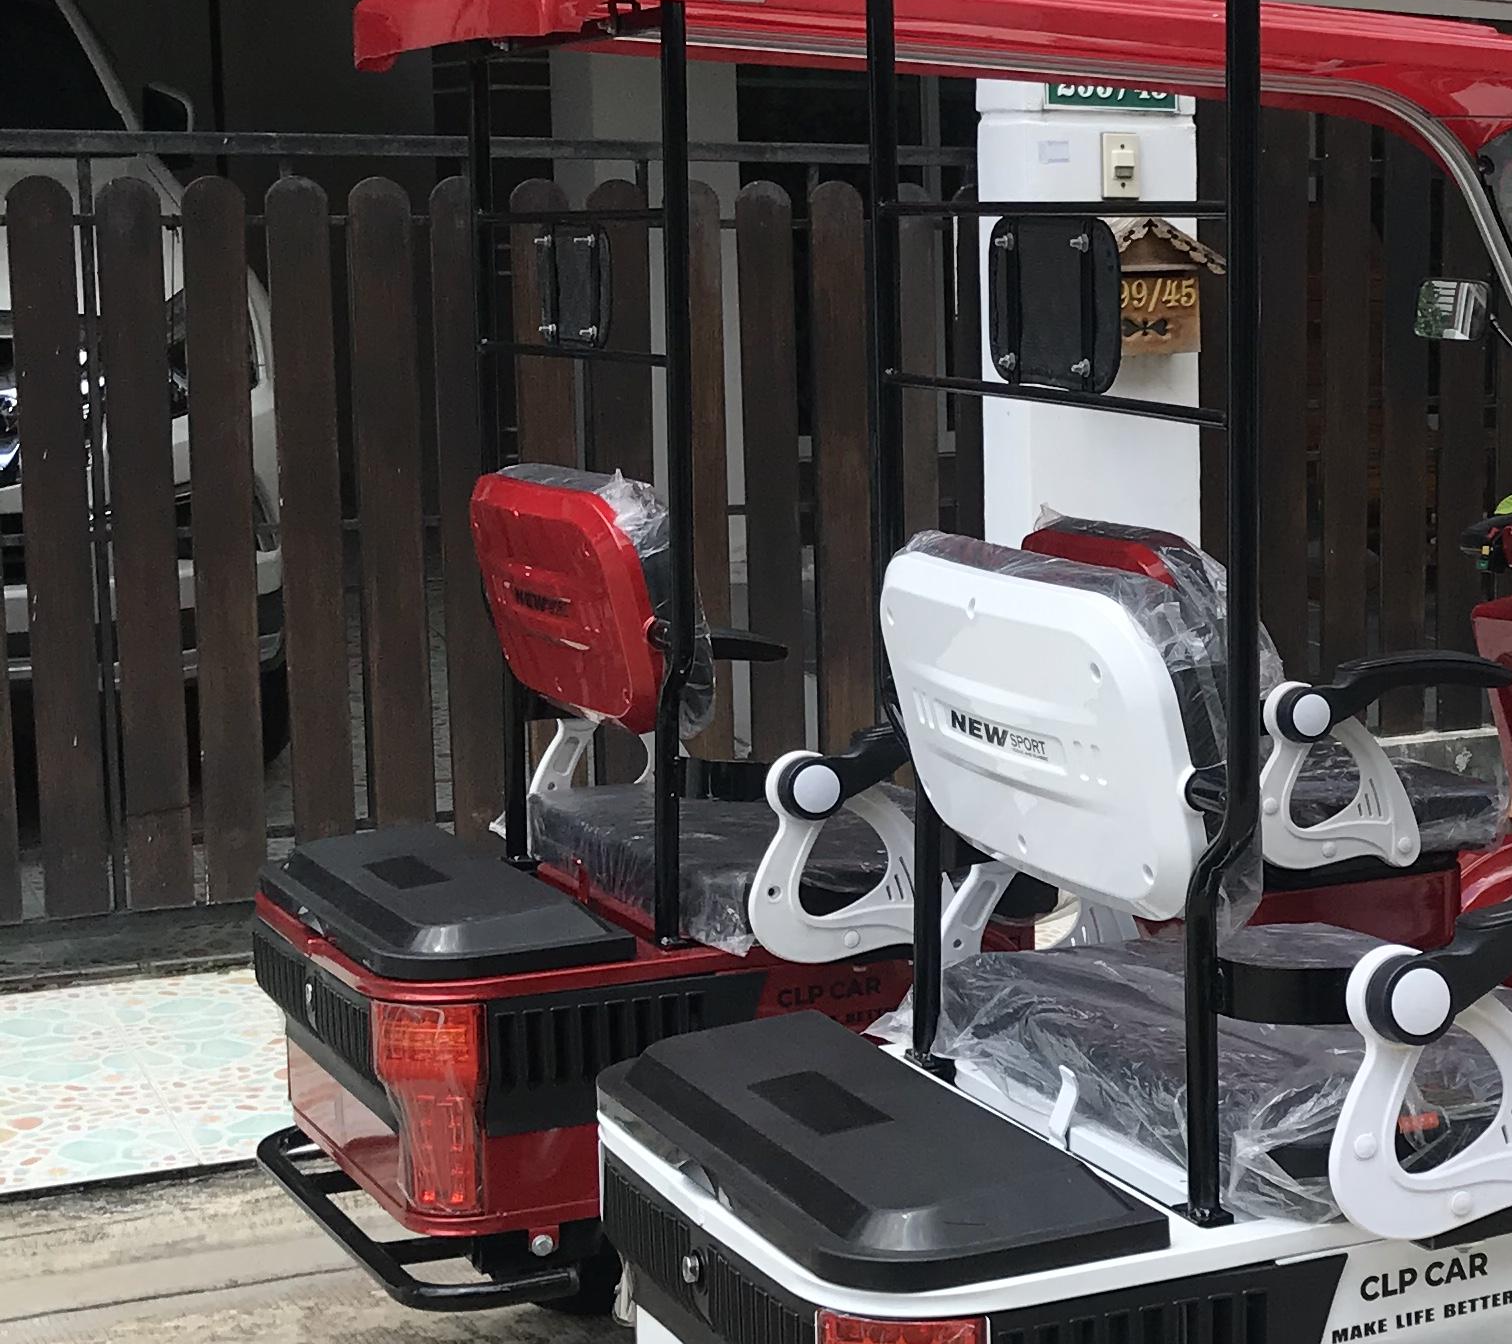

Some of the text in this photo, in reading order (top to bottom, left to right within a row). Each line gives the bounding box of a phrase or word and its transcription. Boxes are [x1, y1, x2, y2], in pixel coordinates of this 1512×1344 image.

[951, 709, 1009, 747] NEW
[1009, 733, 1046, 755] SPORT
[777, 976, 881, 1008] CLP CAR
[1360, 1252, 1488, 1302] CLP CAR
[1331, 1318, 1388, 1344] MAKE
[1396, 1307, 1435, 1330] LIFE
